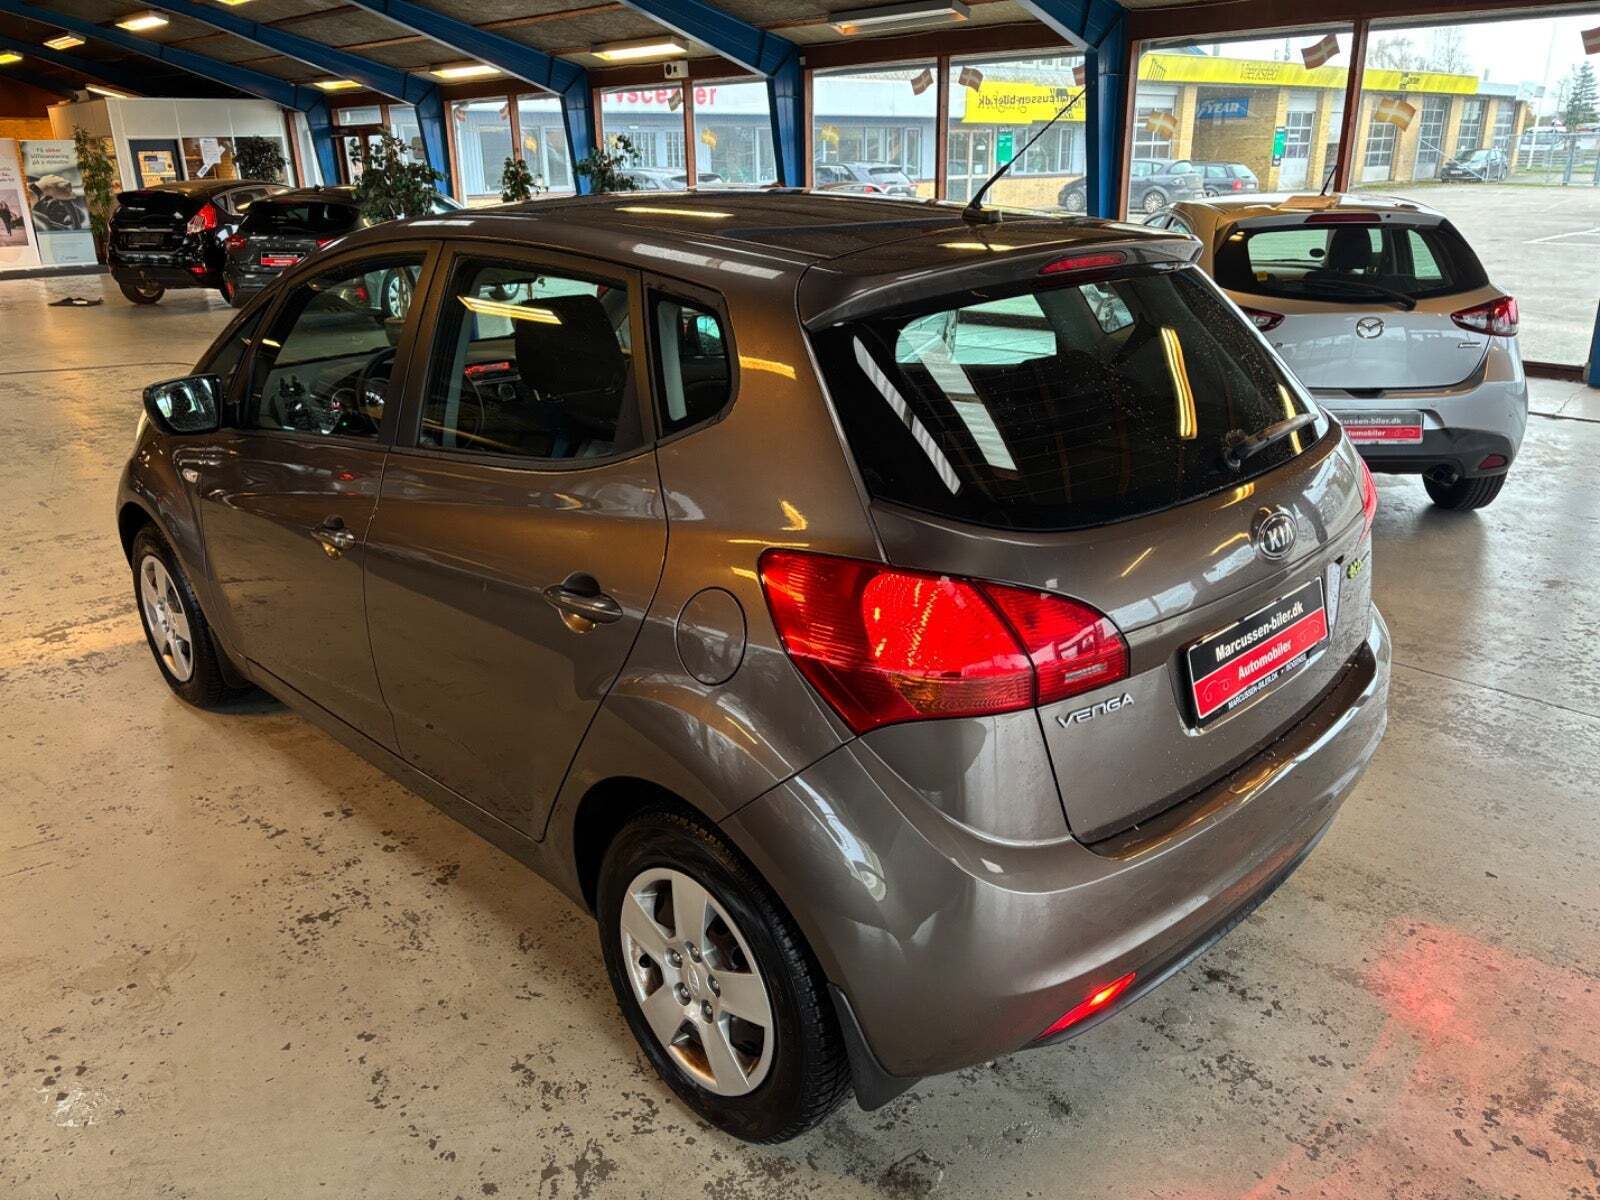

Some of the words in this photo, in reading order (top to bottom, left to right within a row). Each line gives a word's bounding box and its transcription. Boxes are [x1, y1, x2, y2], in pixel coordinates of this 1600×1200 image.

[1267, 522, 1294, 551] KIA
[1215, 600, 1305, 662] Marcussen-biler.dk
[1238, 640, 1292, 680] Automobiler
[1056, 692, 1135, 728] VENGA
[1228, 672, 1280, 710] MARCUSSEN-BILER.DK
